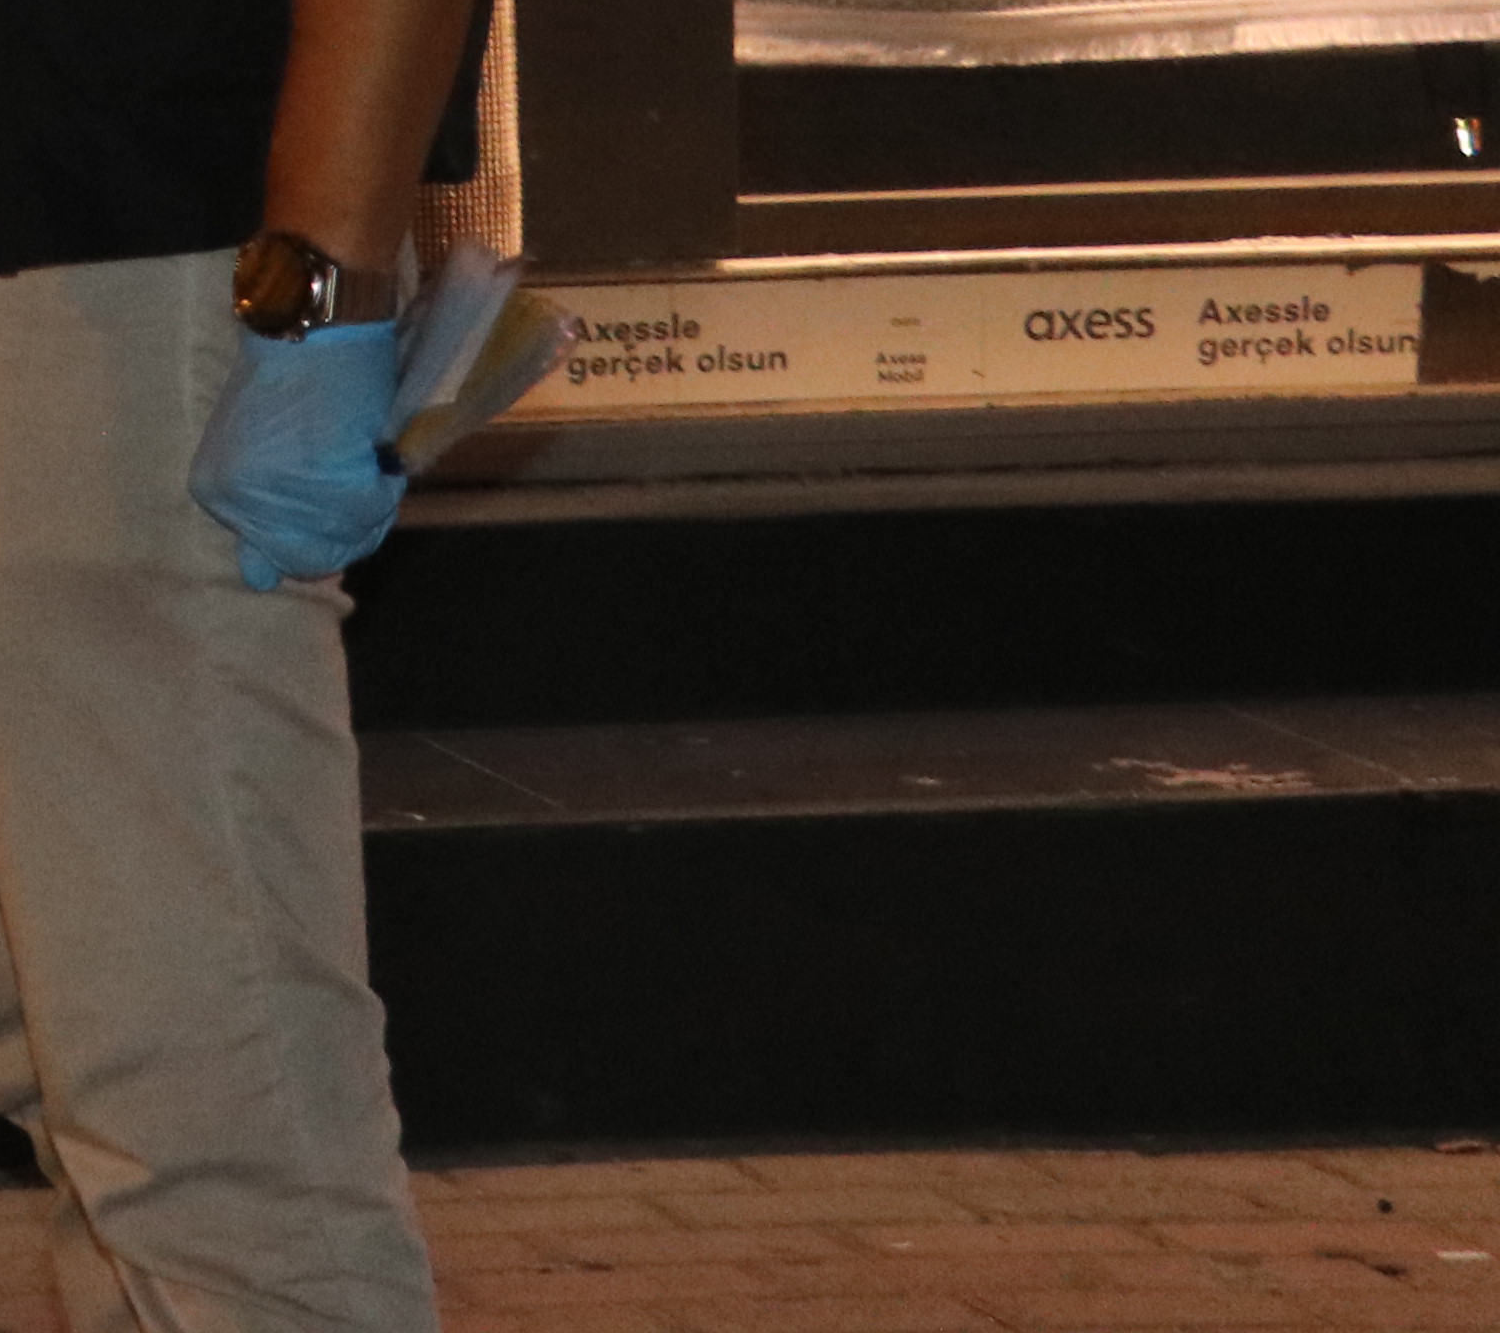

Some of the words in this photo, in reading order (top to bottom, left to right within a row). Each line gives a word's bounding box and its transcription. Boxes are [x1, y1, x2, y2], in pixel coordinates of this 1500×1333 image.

[572, 311, 700, 343] Axessle
[1024, 307, 1155, 342] axess
[1199, 295, 1331, 325] Axessle
[567, 346, 685, 385] gerçek
[697, 344, 788, 374] olsun
[1198, 329, 1316, 367] gerçek
